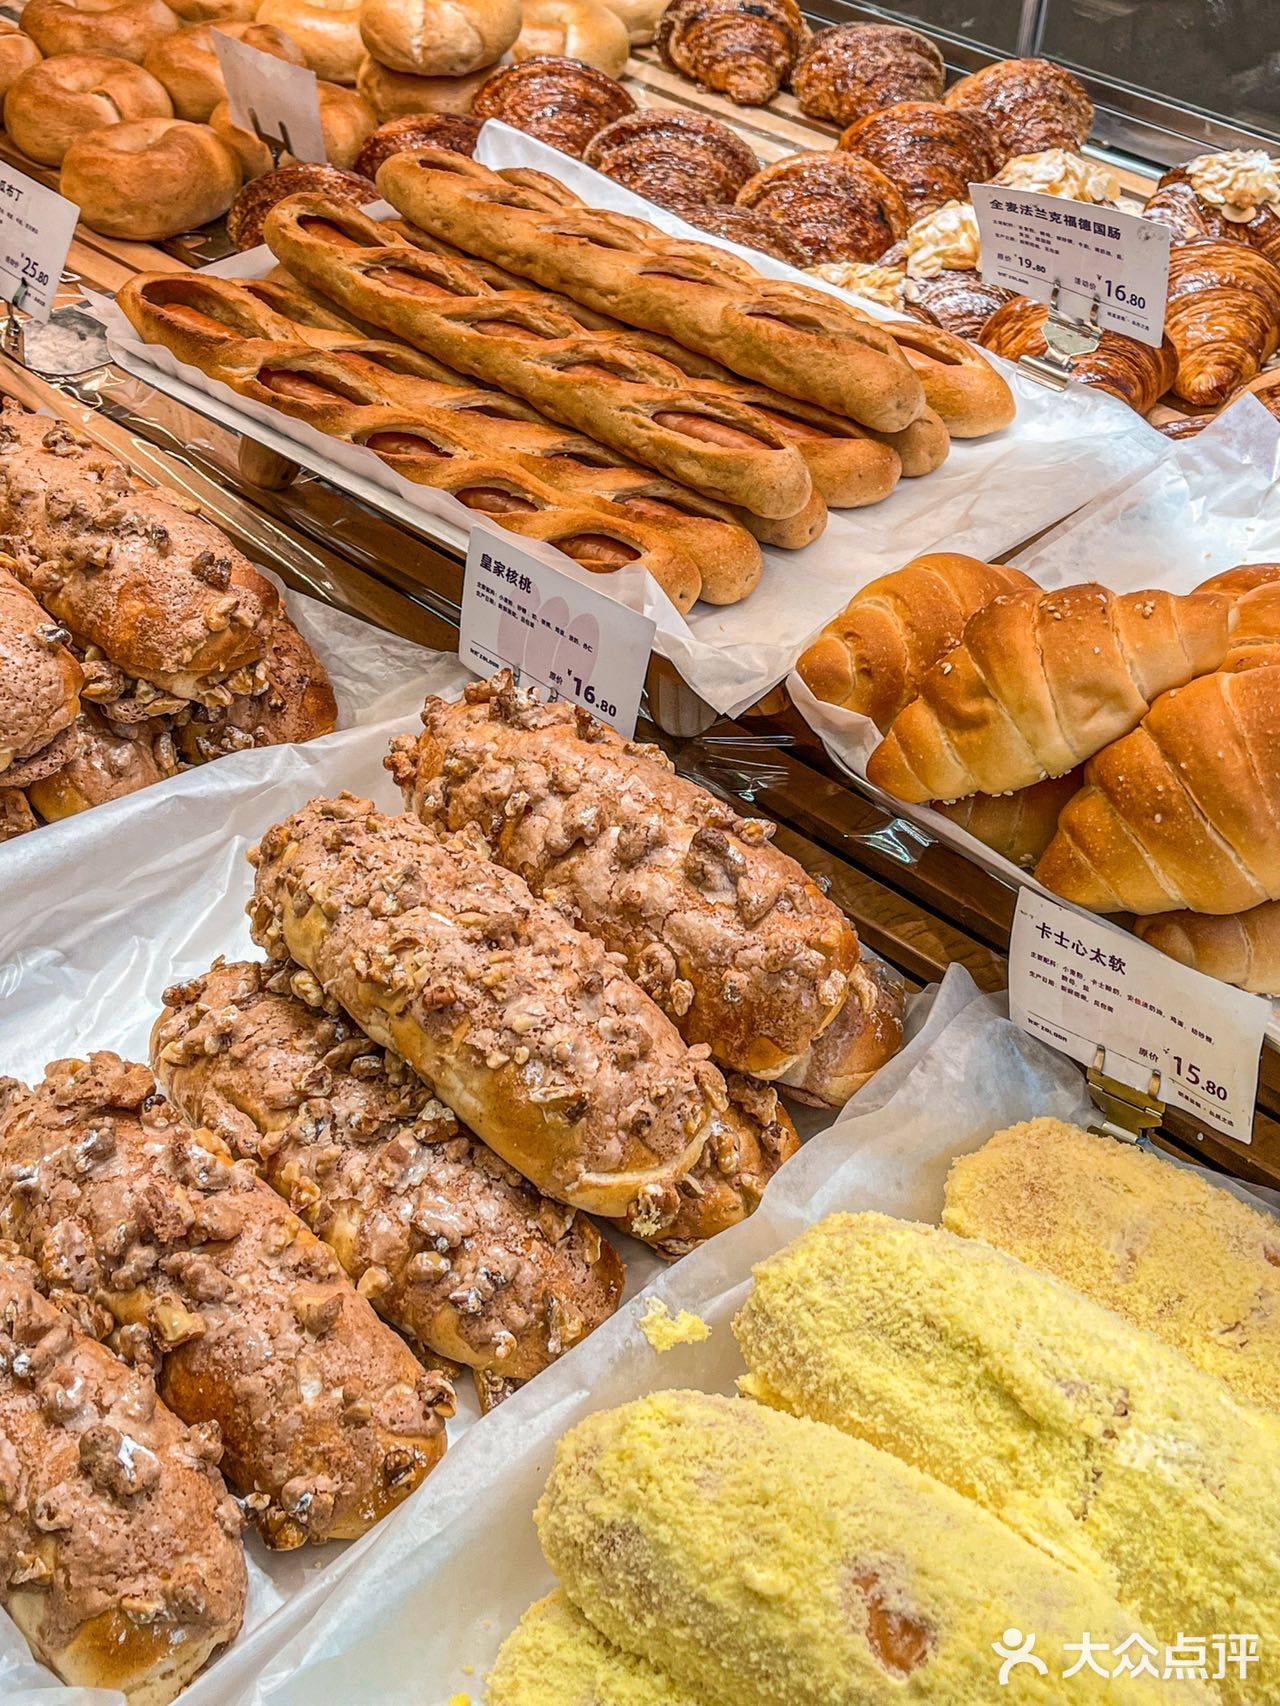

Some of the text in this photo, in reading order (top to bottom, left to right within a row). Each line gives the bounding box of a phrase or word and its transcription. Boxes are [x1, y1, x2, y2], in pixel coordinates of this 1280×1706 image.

[989, 199, 1122, 241] 全麦法兰克福德国肠
[479, 553, 533, 594] 皇家核桃
[1035, 921, 1127, 975] 卡士心太软
[1138, 1046, 1160, 1063] 原价
